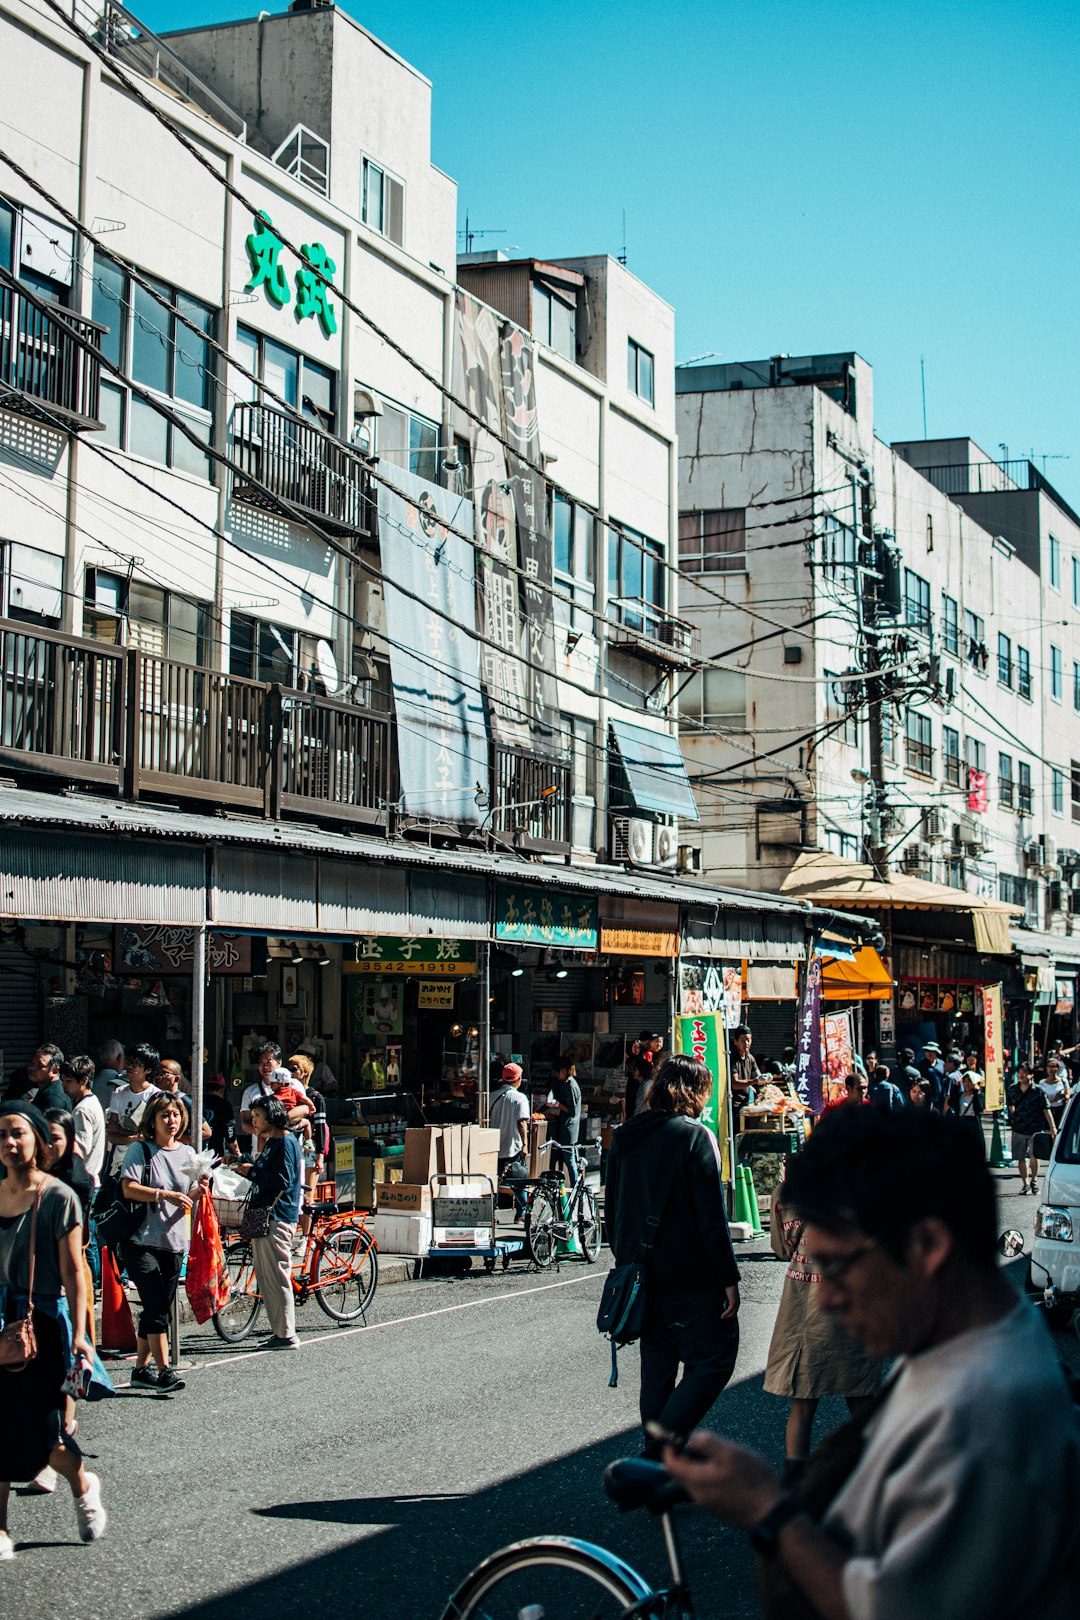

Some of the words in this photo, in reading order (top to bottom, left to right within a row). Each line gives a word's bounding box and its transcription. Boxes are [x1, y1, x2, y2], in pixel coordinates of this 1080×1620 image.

[244, 209, 337, 334] 丸武
[360, 936, 461, 960] 玉子焼
[362, 962, 456, 972] 3542-1919
[421, 984, 452, 993] おみやげ
[420, 996, 452, 1004] こちらです
